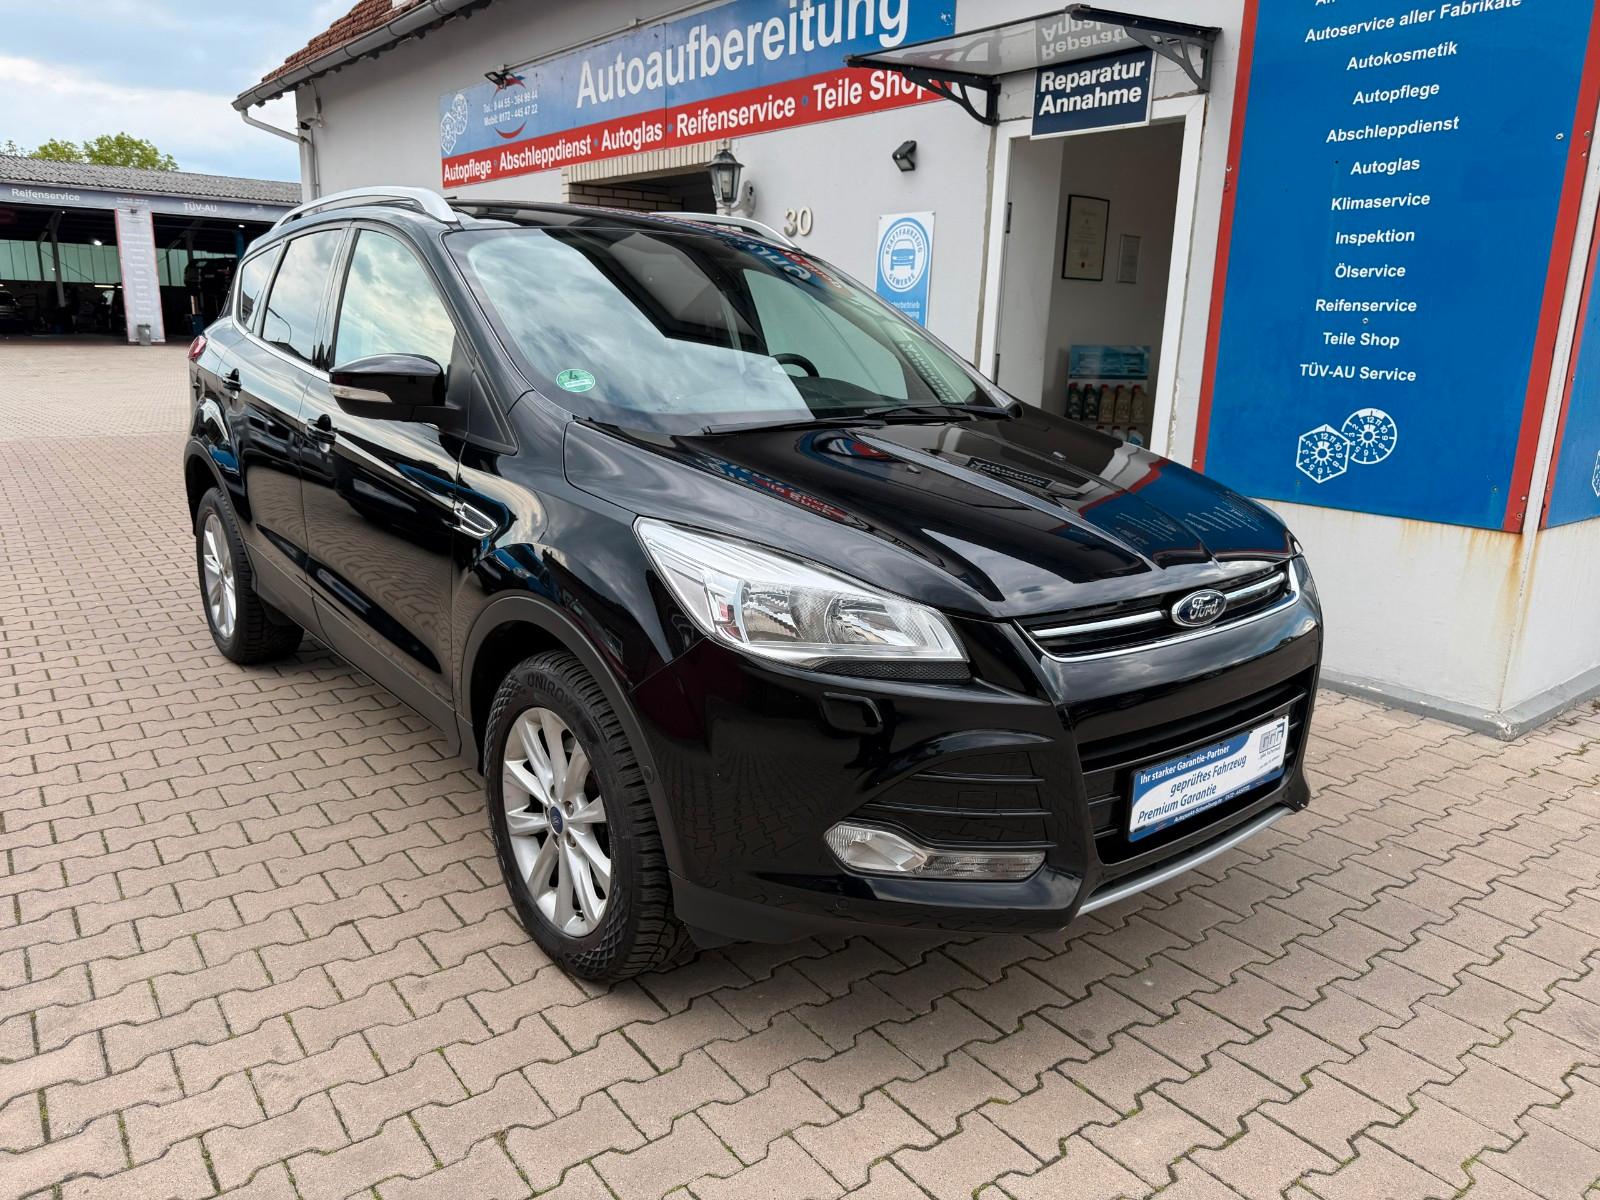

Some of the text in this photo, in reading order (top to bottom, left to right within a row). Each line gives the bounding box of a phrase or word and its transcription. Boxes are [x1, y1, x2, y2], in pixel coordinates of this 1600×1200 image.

[1304, 0, 1521, 42] Autoservice aller Fabrikate
[576, 0, 908, 108] Autoaufbereitung
[1346, 41, 1458, 71] Autokosmetik
[1040, 60, 1146, 93] Reparatur
[813, 78, 863, 112] Teile
[1039, 86, 1142, 116] Annahme
[1352, 83, 1440, 105] Autopflege
[676, 95, 796, 138] Reifenservice
[1326, 116, 1460, 143] Abschleppdienst
[601, 121, 663, 151] Autoglas
[499, 134, 591, 171] Abschleppdienst
[1350, 157, 1420, 175] Autoglas
[444, 157, 492, 182] Autopflege
[11, 187, 80, 202] Reifenservice
[183, 201, 217, 213] TÜV-AU
[1331, 193, 1431, 211] Klimaservice
[783, 206, 813, 237] 30
[1335, 230, 1415, 246] Inspektion
[1335, 263, 1406, 278] Ölservice
[1315, 299, 1417, 313] Reifenservice
[1323, 332, 1400, 349] Teile Shop
[1300, 363, 1416, 382] TÜV-AU Service
[1190, 595, 1218, 620] Ford
[1140, 745, 1230, 785] Ihr starker Garantie-Partner
[1170, 770, 1211, 797] geprüftes
[1212, 754, 1247, 779] Fahrzeug
[1138, 800, 1179, 823] Premium
[1180, 783, 1217, 807] Garantie
